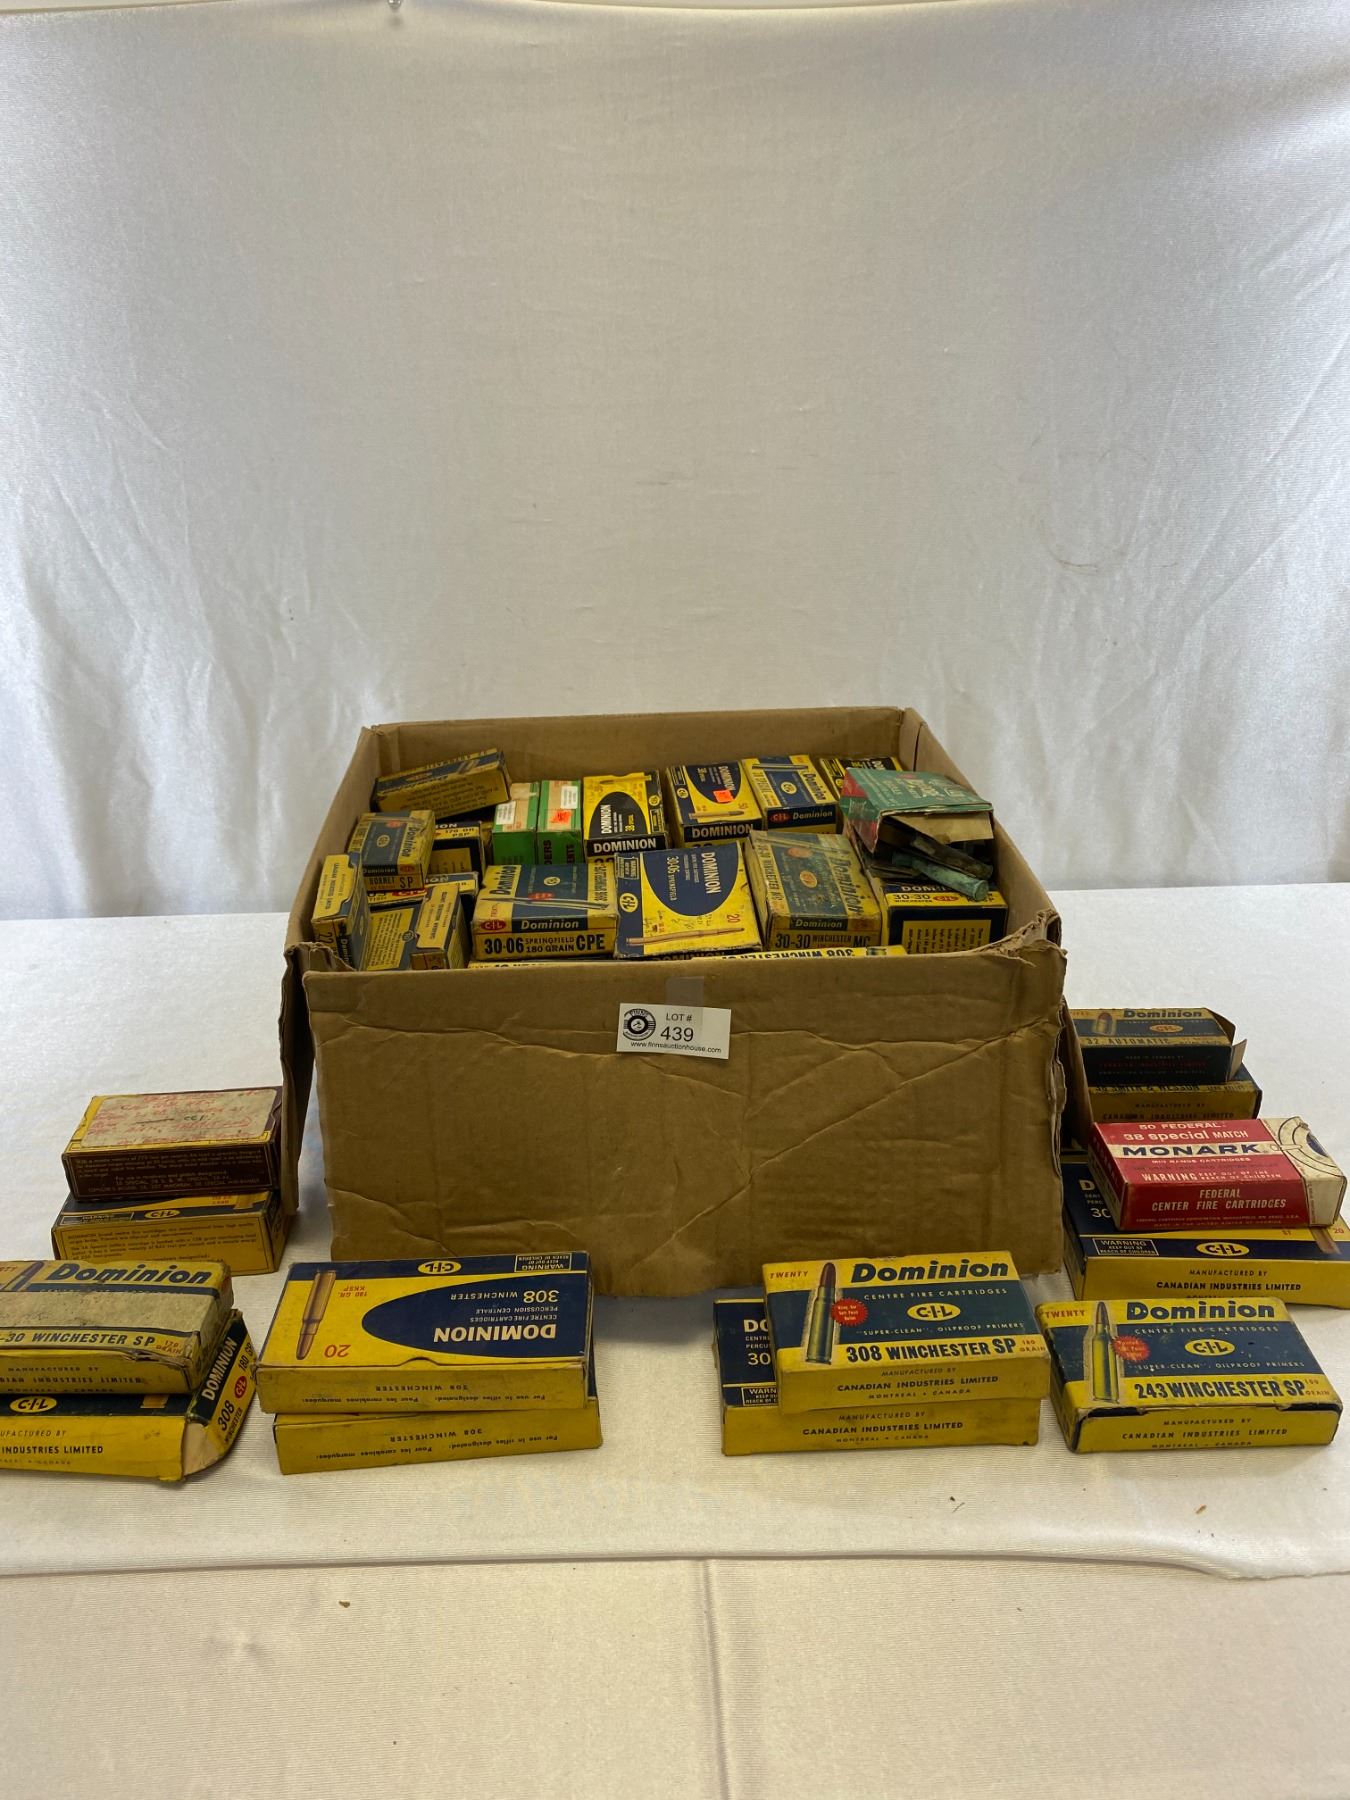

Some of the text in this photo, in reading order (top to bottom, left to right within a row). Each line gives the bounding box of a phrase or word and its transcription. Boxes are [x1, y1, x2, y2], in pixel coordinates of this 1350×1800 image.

[792, 810, 833, 820] Dominion
[692, 823, 754, 839] DOMINION
[593, 837, 657, 853] DOMINION
[700, 851, 722, 894] DOMINION
[400, 876, 414, 889] SP
[489, 865, 518, 896] Dominion
[726, 913, 740, 923] 20
[795, 920, 843, 928] Dominion
[521, 920, 580, 930] Dominion
[525, 936, 575, 945] SPRINGFIELD
[575, 933, 605, 951] CPE
[774, 933, 811, 949] 30-30
[525, 944, 575, 953] 180 GRAIN
[665, 1013, 693, 1022] LOT #
[1123, 1008, 1202, 1018] Dominion
[660, 1026, 694, 1042] 439
[1123, 1130, 1248, 1142] 38 special MATCH
[1122, 1143, 1264, 1156] MONARK
[1141, 1172, 1198, 1182] WARNING
[1200, 1188, 1241, 1199] FEDERAL
[1151, 1198, 1287, 1212] CENTER FIRE CARTRIDGES
[45, 1263, 213, 1285] Dominion
[769, 1258, 1009, 1284] TWENTY Dominion
[1156, 1281, 1206, 1290] CANADIAN
[1265, 1283, 1302, 1291] LIMITED
[450, 1289, 560, 1304] 308 WINCHESTER
[863, 1292, 905, 1301] CENTRE
[938, 1288, 1008, 1297] CARTRIDGES
[475, 1307, 511, 1315] CENTRALE
[1045, 1300, 1275, 1321] TWENTY Dominion
[469, 1315, 514, 1323] CARTRIDGES
[433, 1323, 557, 1343] DOMINION
[937, 1322, 1025, 1332] OILPROOF PRIMERS
[1134, 1327, 1175, 1335] CENTRE
[1209, 1326, 1279, 1334] CARTRIDGES
[31, 1333, 179, 1348] WINCHESTER SP 170
[323, 1344, 352, 1358] 20
[845, 1337, 1016, 1363] 308 WINCHESTER SP
[747, 1352, 771, 1366] 30
[201, 1336, 238, 1401] DOMINION
[881, 1367, 943, 1377] MANUFACTURED
[375, 1384, 443, 1392] WINCHESTER
[837, 1375, 999, 1392] CANADIAN INDUSTRIES LIMITED
[1134, 1383, 1168, 1399] 243
[1167, 1379, 1282, 1398] WINCHESTER
[1282, 1380, 1306, 1397] SP
[868, 1388, 971, 1399] MONTREAL CANADA
[217, 1399, 235, 1431] 308
[838, 1411, 911, 1421] MANUFACTURED
[224, 1407, 243, 1445] WINCHESTER
[802, 1421, 964, 1436] CANADIAN INDUSTRIES LIMITED
[1163, 1418, 1235, 1426] MANUFACTURED
[389, 1428, 482, 1443] 308 WINCHESTER
[1122, 1428, 1288, 1440] CANADIAN INDUSTRIES LIMITED
[1, 1446, 104, 1454] INDUSTRIES LIMITED
